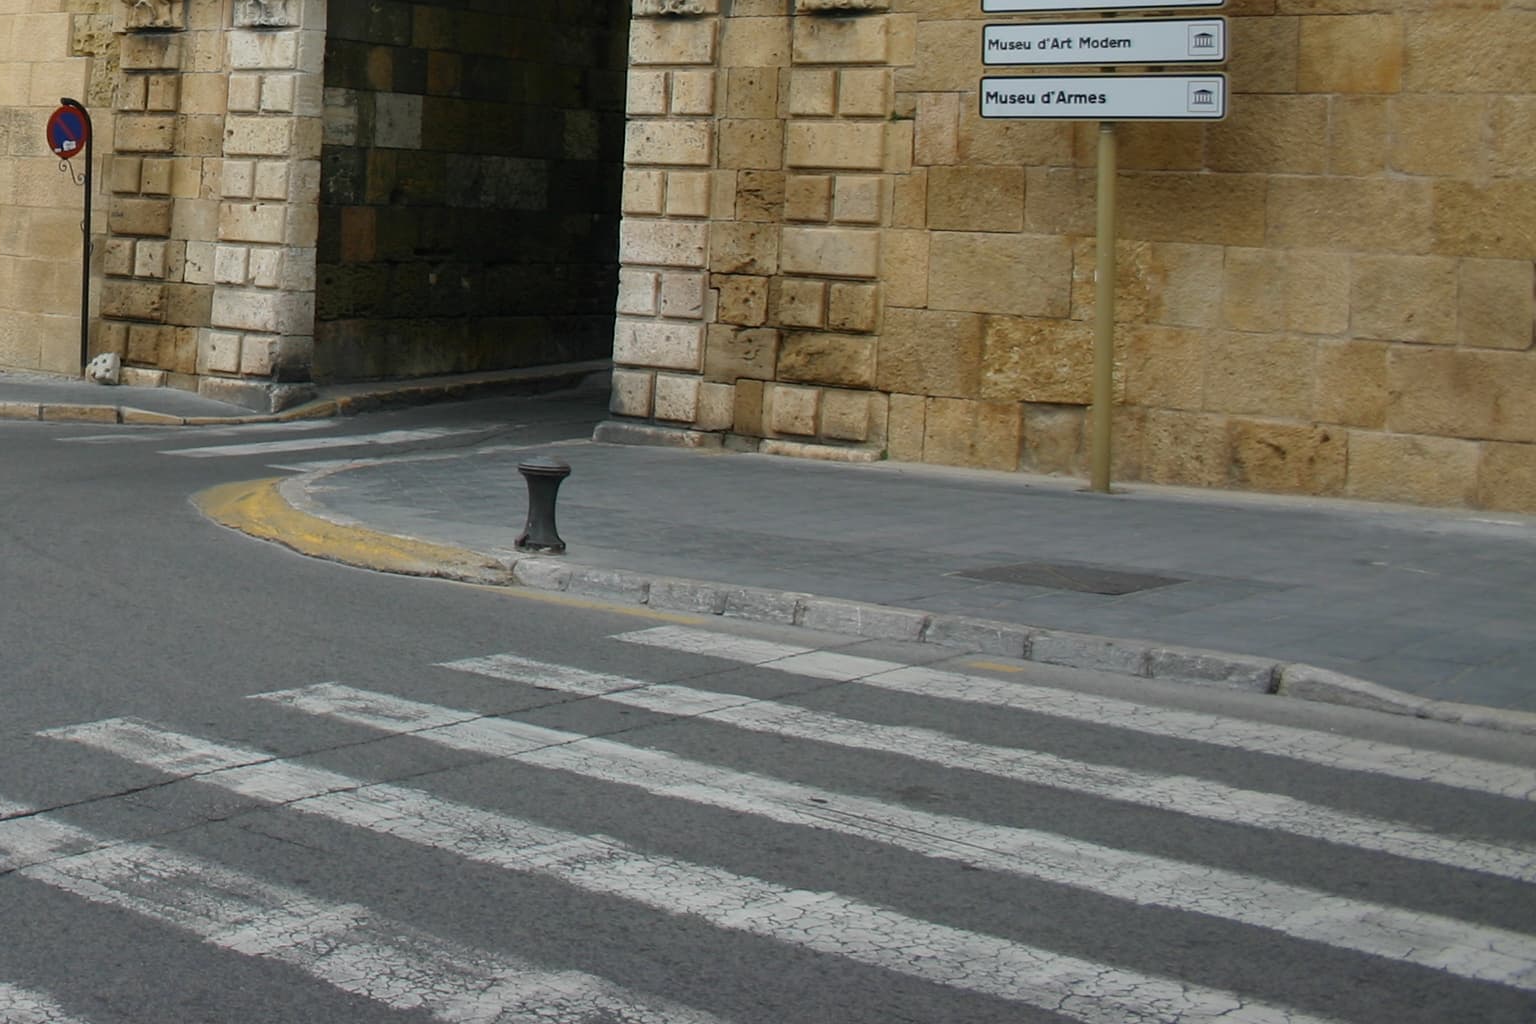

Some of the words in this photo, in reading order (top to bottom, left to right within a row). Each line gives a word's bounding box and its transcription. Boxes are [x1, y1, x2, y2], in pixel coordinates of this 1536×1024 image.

[988, 38, 1031, 51] Museu
[1037, 37, 1072, 50] d'Art
[1078, 36, 1132, 49] Modern
[985, 91, 1035, 105] Museu
[1041, 90, 1107, 104] d'Armes
